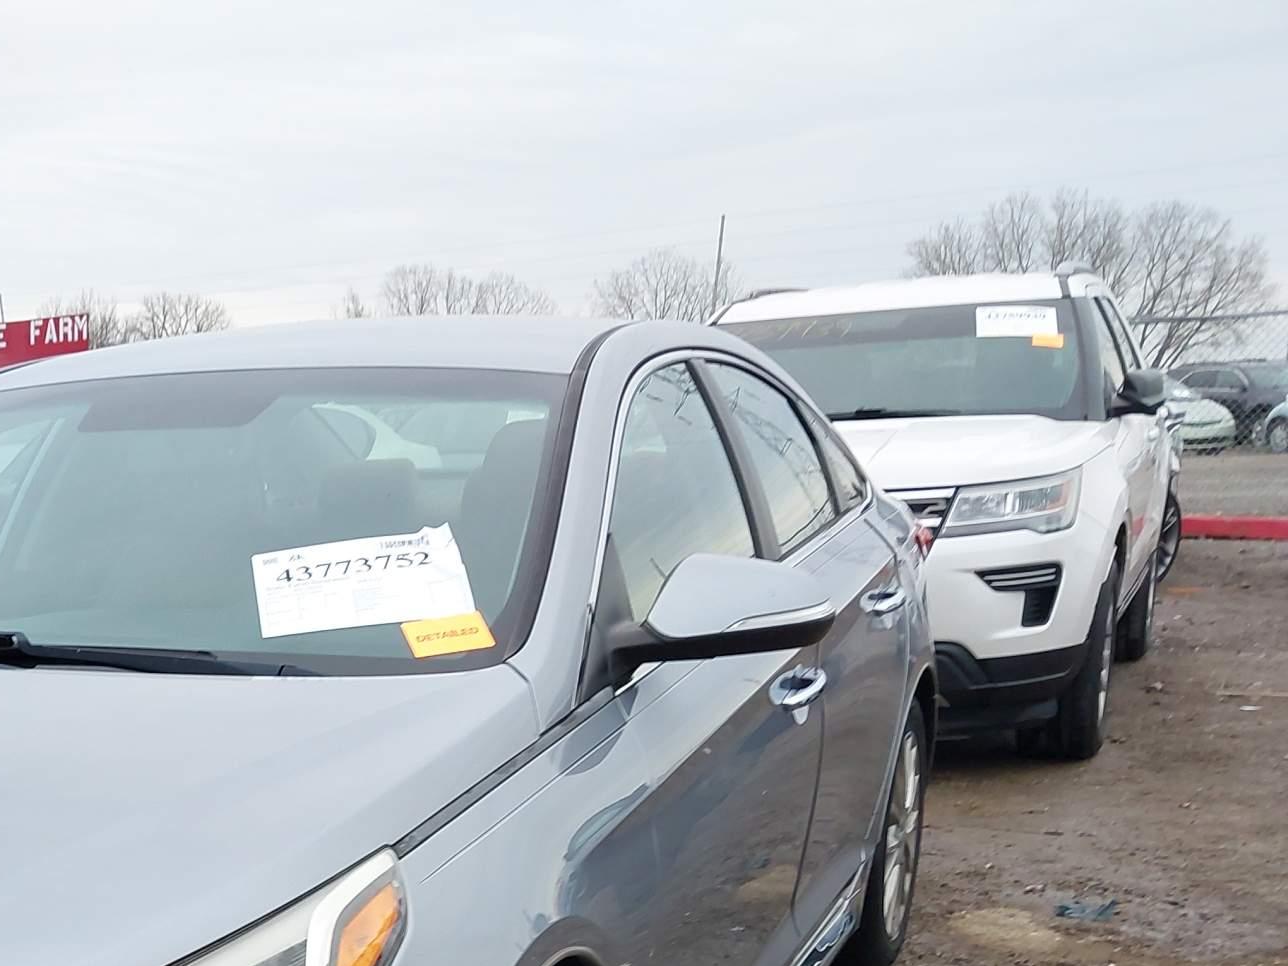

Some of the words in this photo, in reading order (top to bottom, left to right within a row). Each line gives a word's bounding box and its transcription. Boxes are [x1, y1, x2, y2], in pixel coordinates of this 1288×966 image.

[30, 314, 88, 346] FARM
[276, 551, 433, 583] 43773752
[415, 625, 480, 644] DETAILED
